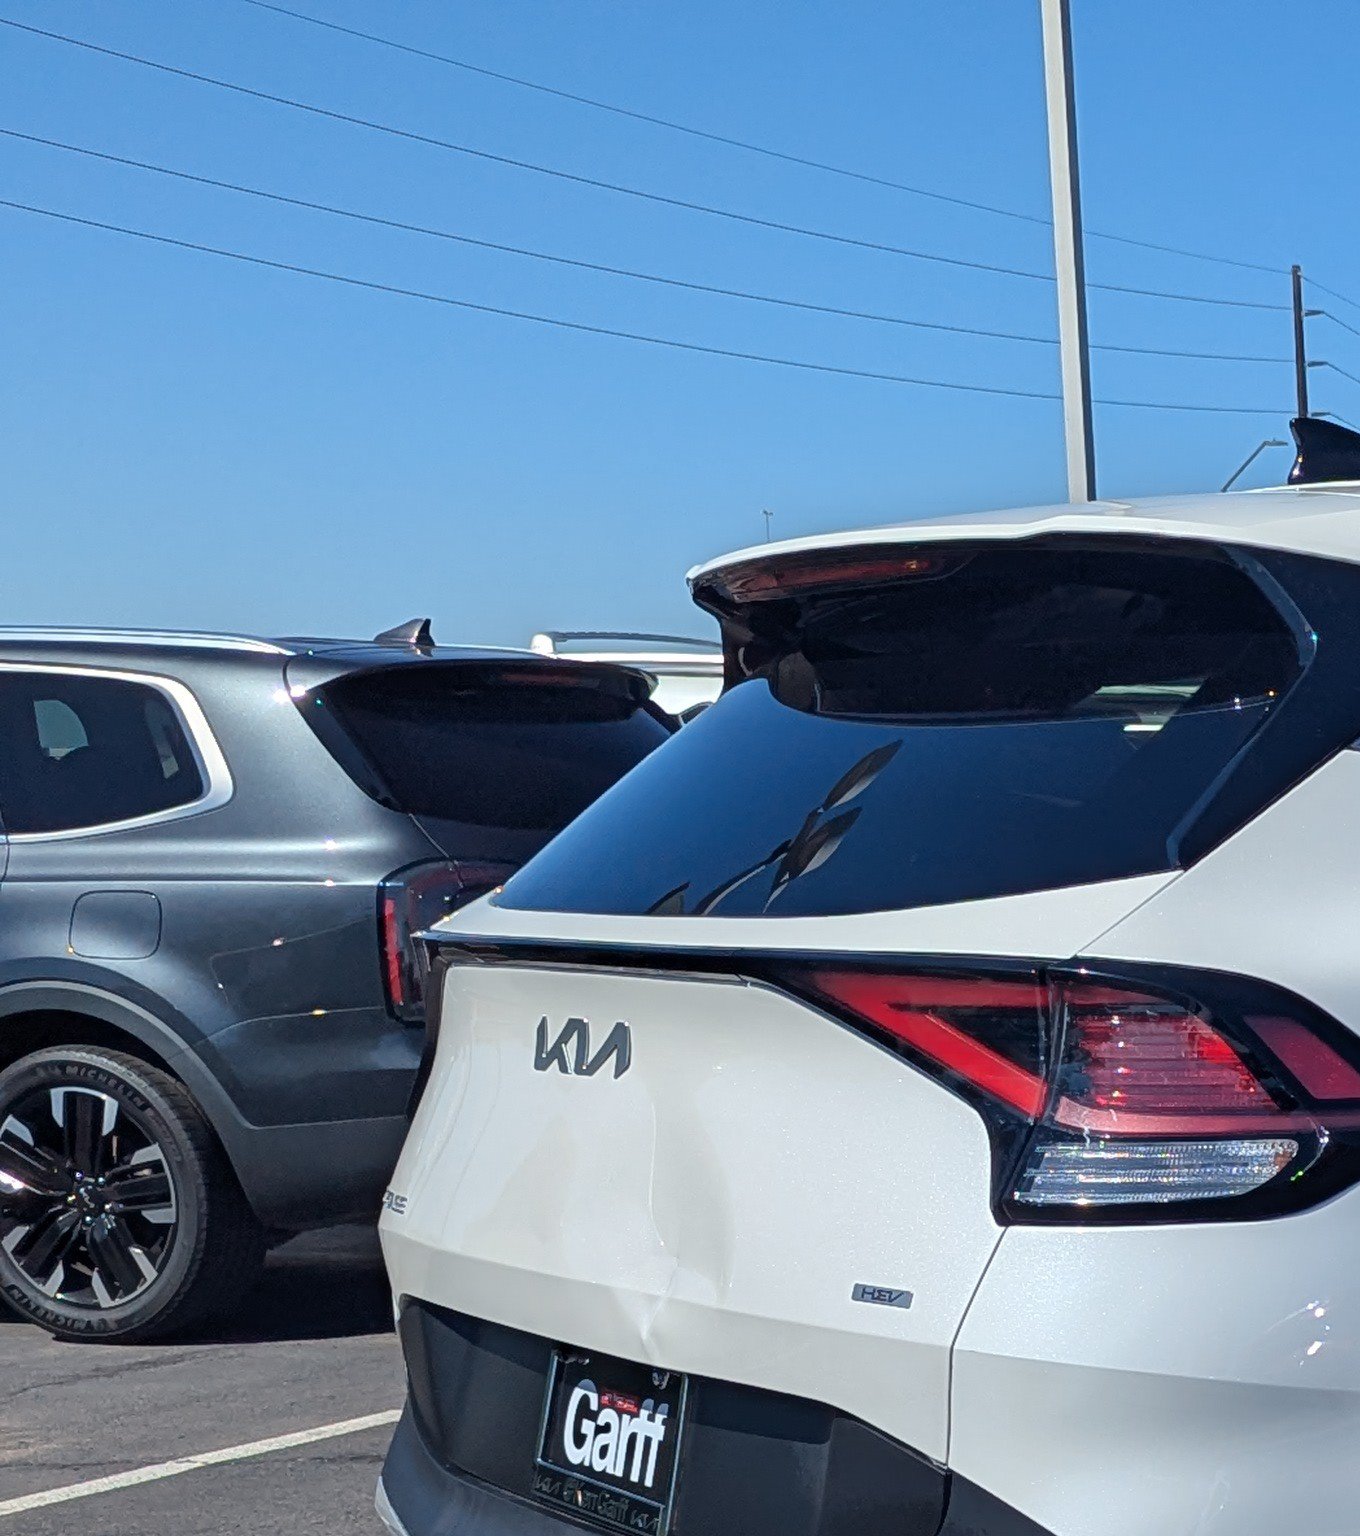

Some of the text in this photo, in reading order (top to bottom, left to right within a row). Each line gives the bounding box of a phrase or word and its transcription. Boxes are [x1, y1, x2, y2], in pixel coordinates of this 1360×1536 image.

[534, 1015, 631, 1079] KIA
[861, 1288, 905, 1303] HEV
[563, 1378, 669, 1488] Garff
